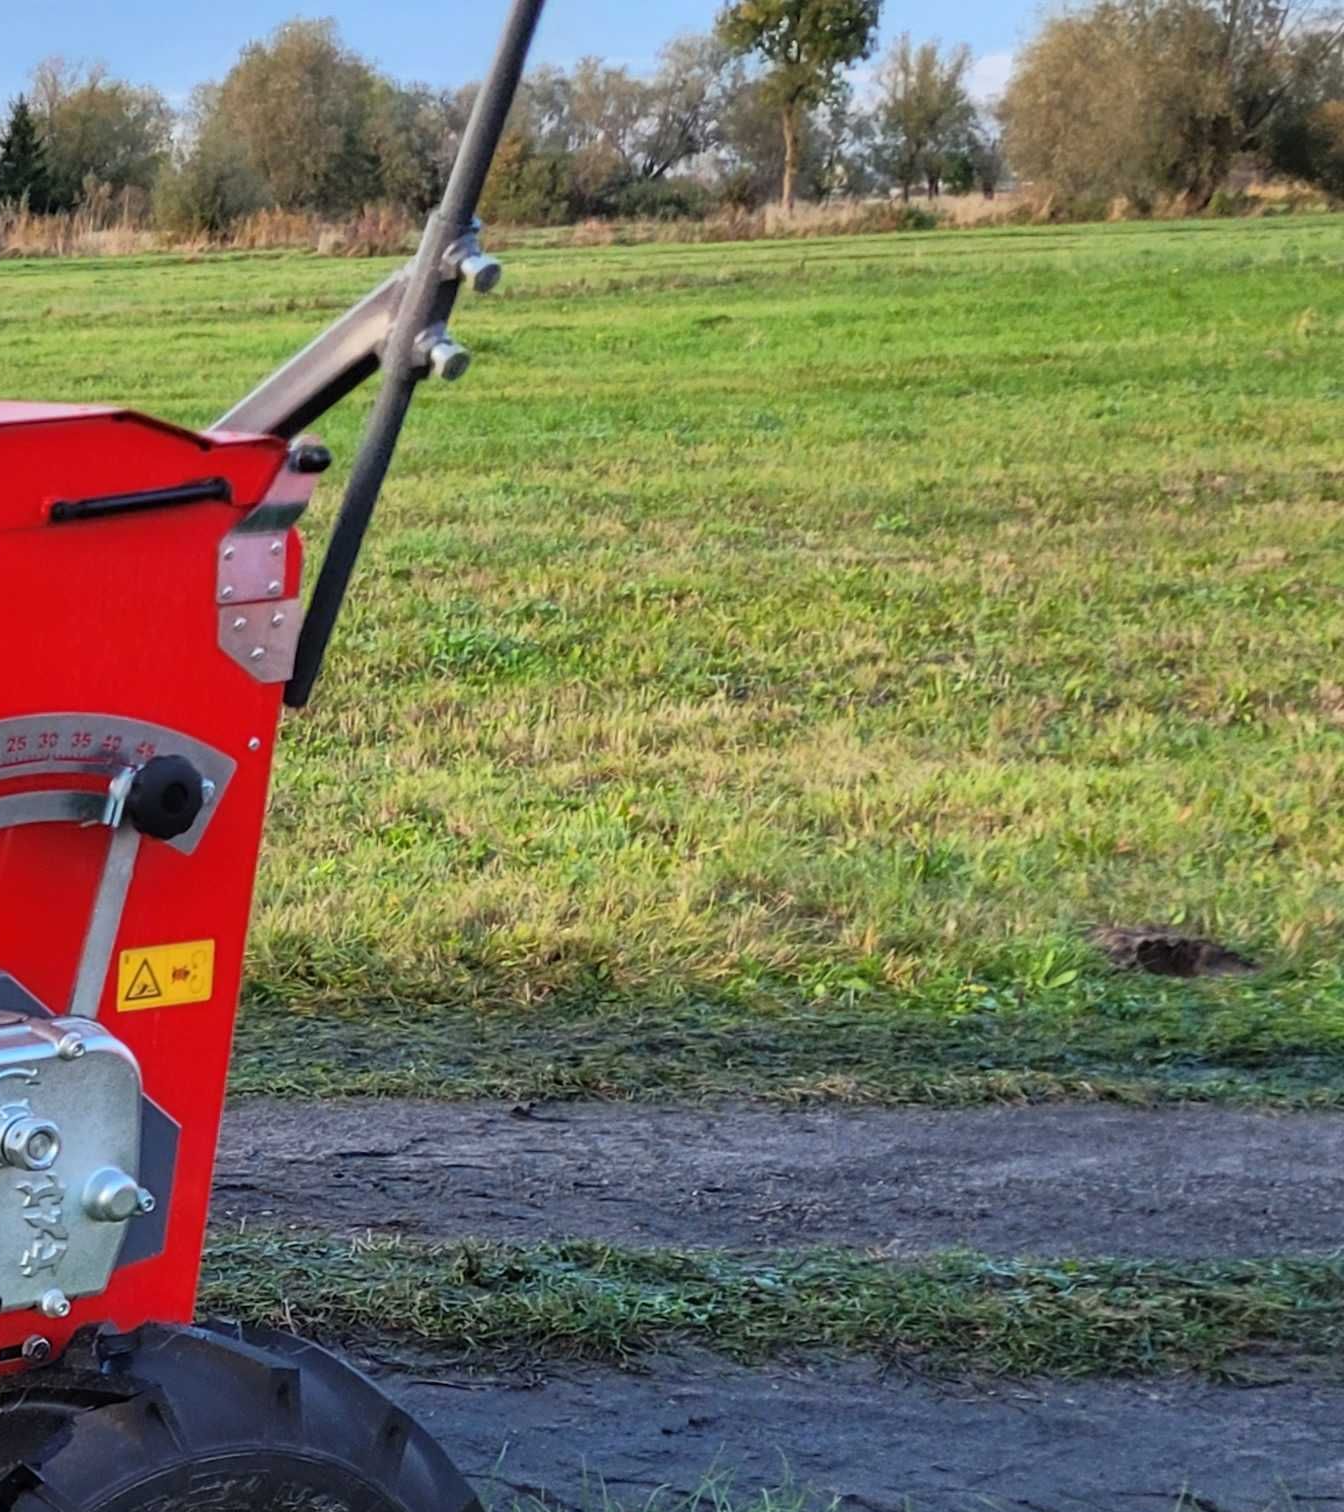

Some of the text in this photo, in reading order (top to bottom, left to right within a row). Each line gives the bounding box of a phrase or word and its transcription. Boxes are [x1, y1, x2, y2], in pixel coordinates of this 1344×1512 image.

[7, 735, 27, 753] 25
[39, 731, 59, 749] 30
[71, 731, 92, 748] 35
[102, 734, 122, 751] 40
